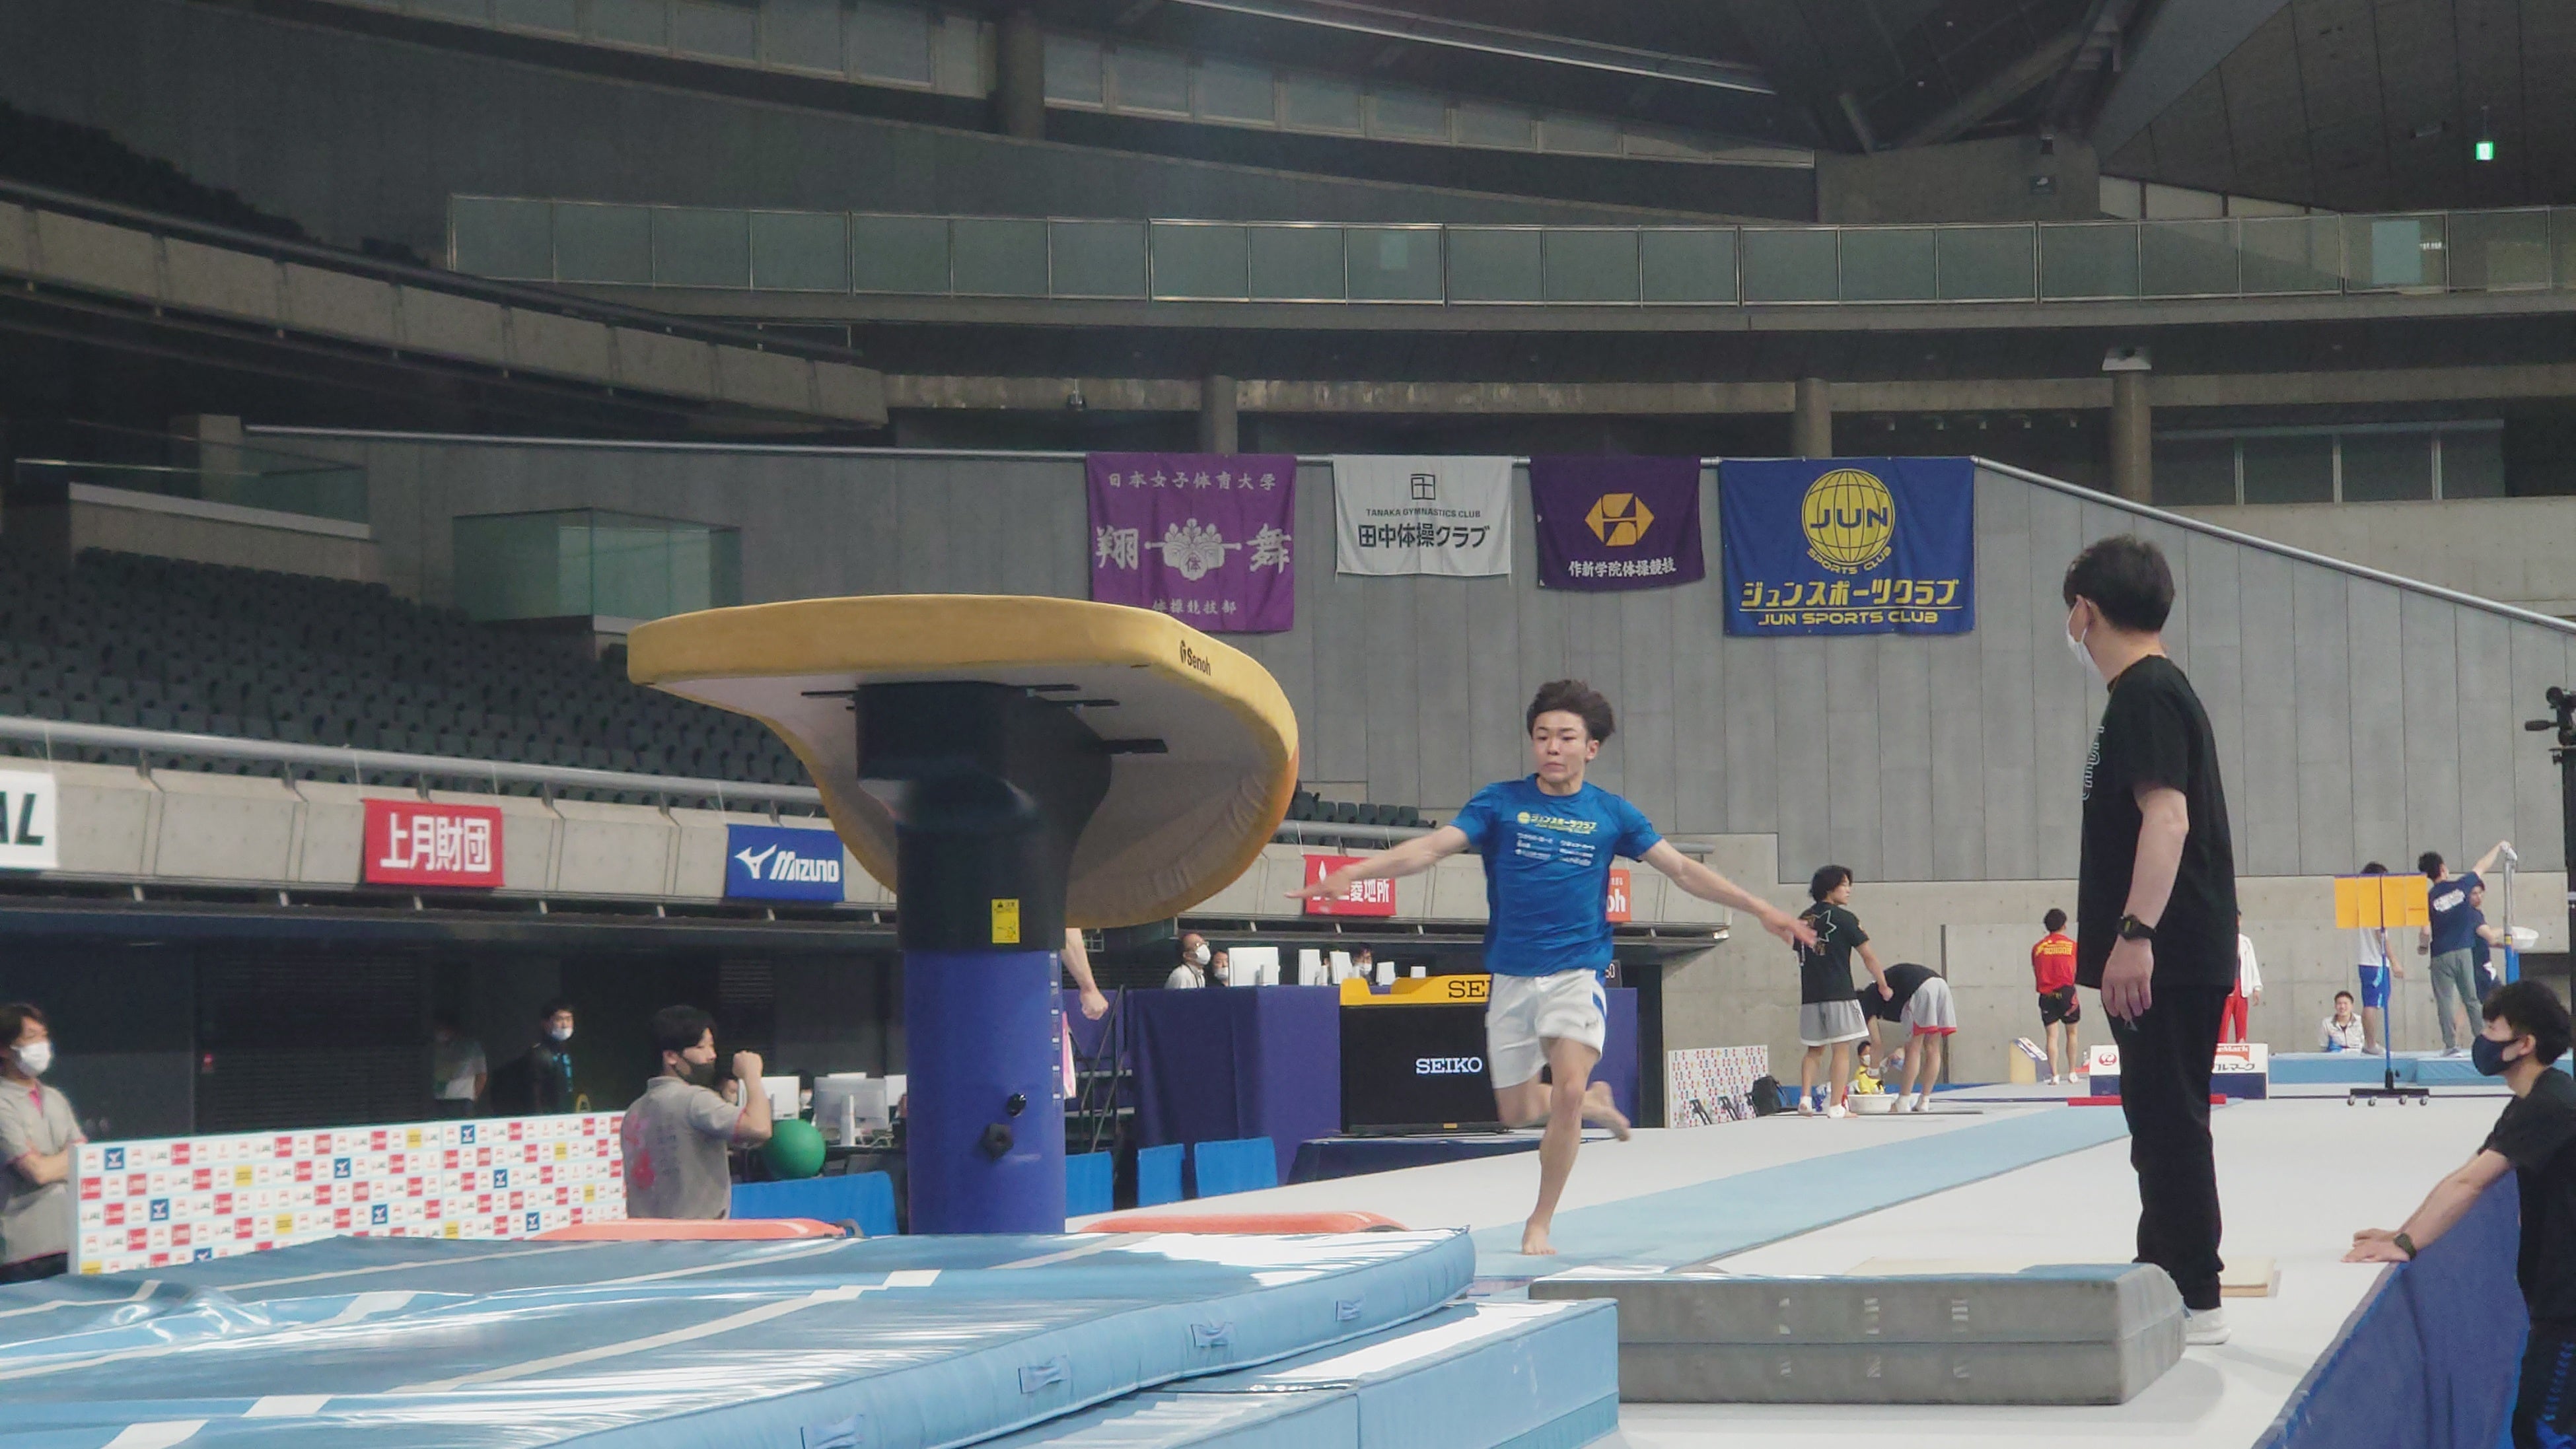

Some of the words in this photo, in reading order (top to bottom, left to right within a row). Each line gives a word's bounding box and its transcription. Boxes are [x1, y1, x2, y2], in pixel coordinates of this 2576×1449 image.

[1108, 471, 1276, 491] 日本女子体育大学
[1402, 508, 1456, 517] GYMNASTICS
[1810, 507, 1888, 528] JUN
[1358, 522, 1490, 548] 田中体操クラブ
[1568, 557, 1677, 577] 作新学院体操競技
[1807, 548, 1858, 575] SPORTS
[1863, 546, 1892, 571] CLUB
[1741, 579, 1960, 607] ジュンスポーツクラブ
[1758, 613, 1797, 625] JUN
[1802, 612, 1884, 625] SPORTS
[1888, 610, 1939, 623] CLUB
[380, 812, 491, 872] 上月財団
[1336, 878, 1390, 903] 菱地所
[1415, 1057, 1483, 1075] SEIKO
